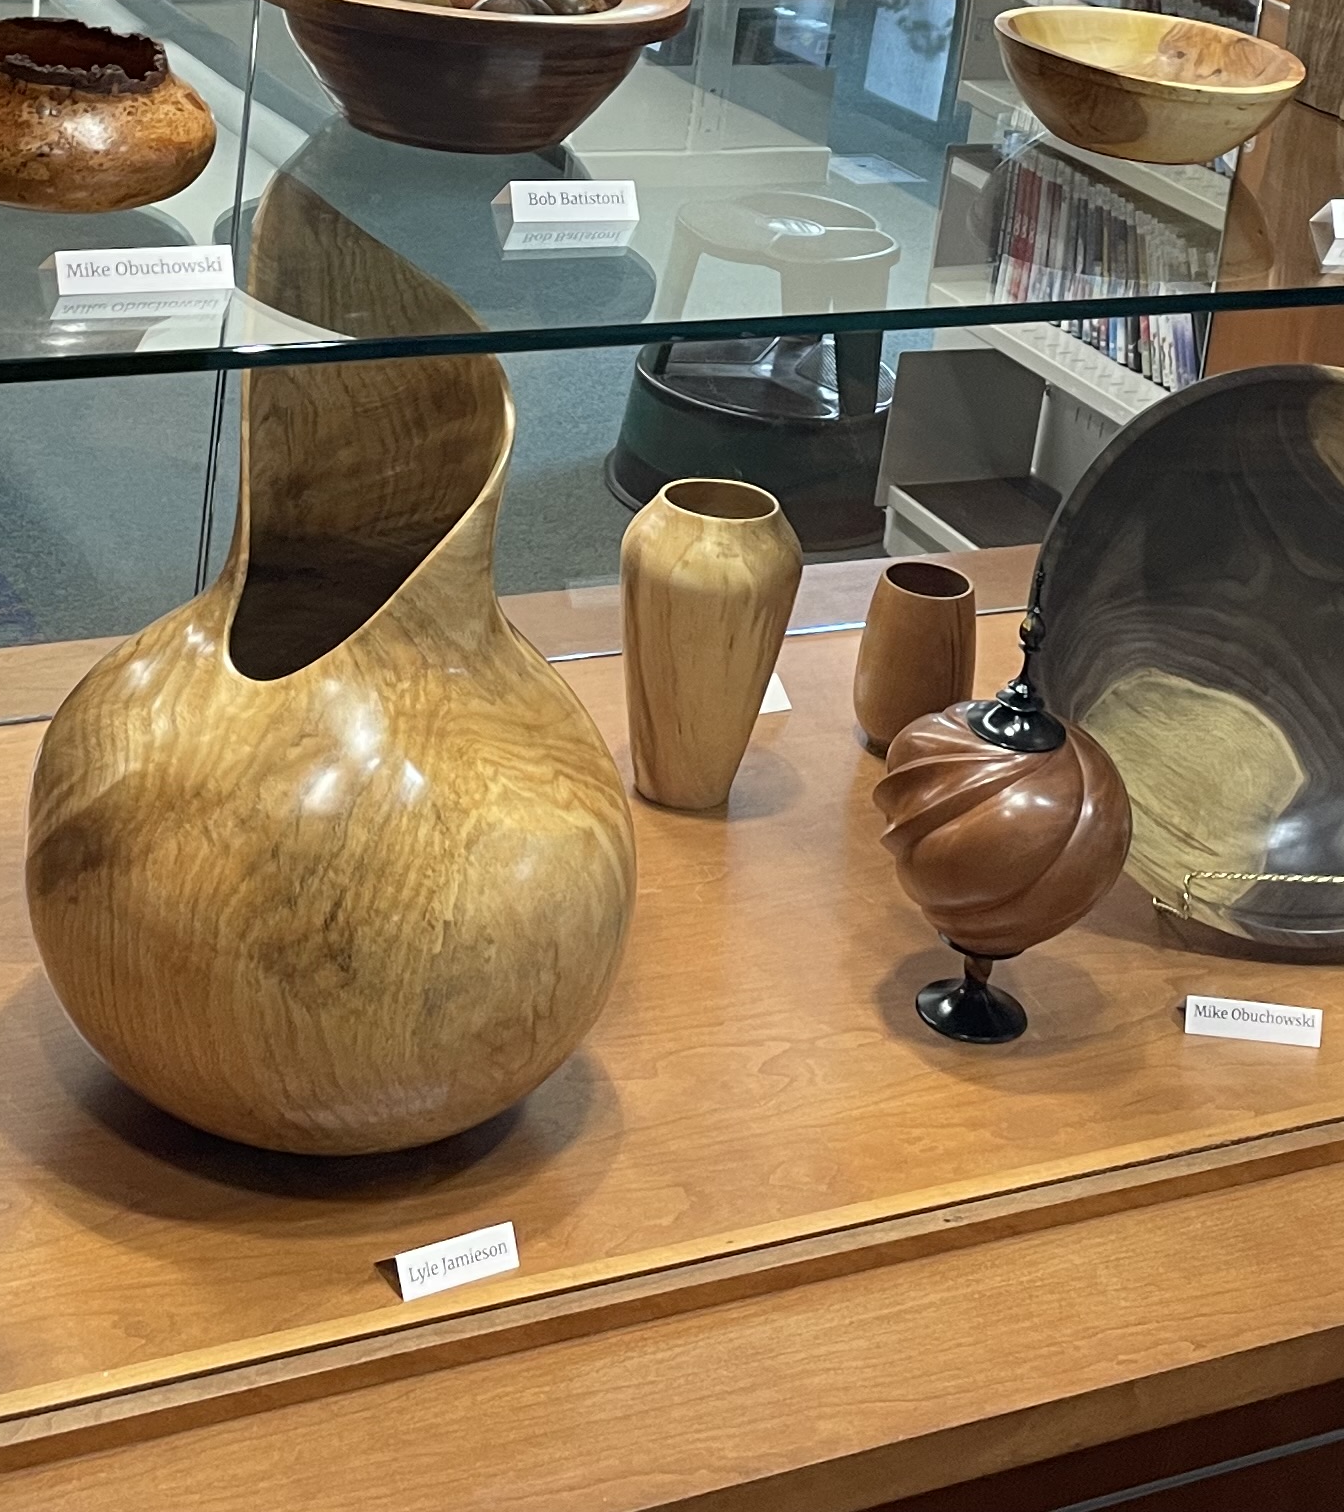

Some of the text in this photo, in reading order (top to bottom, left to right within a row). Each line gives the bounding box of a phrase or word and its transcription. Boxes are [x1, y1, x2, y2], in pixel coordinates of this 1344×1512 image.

[528, 190, 625, 206] Bob Batistoni
[66, 256, 223, 278] Mike Obuchowski
[1194, 1004, 1315, 1028] Mike Obuchowski
[408, 1242, 508, 1284] Lyle Jamieson
